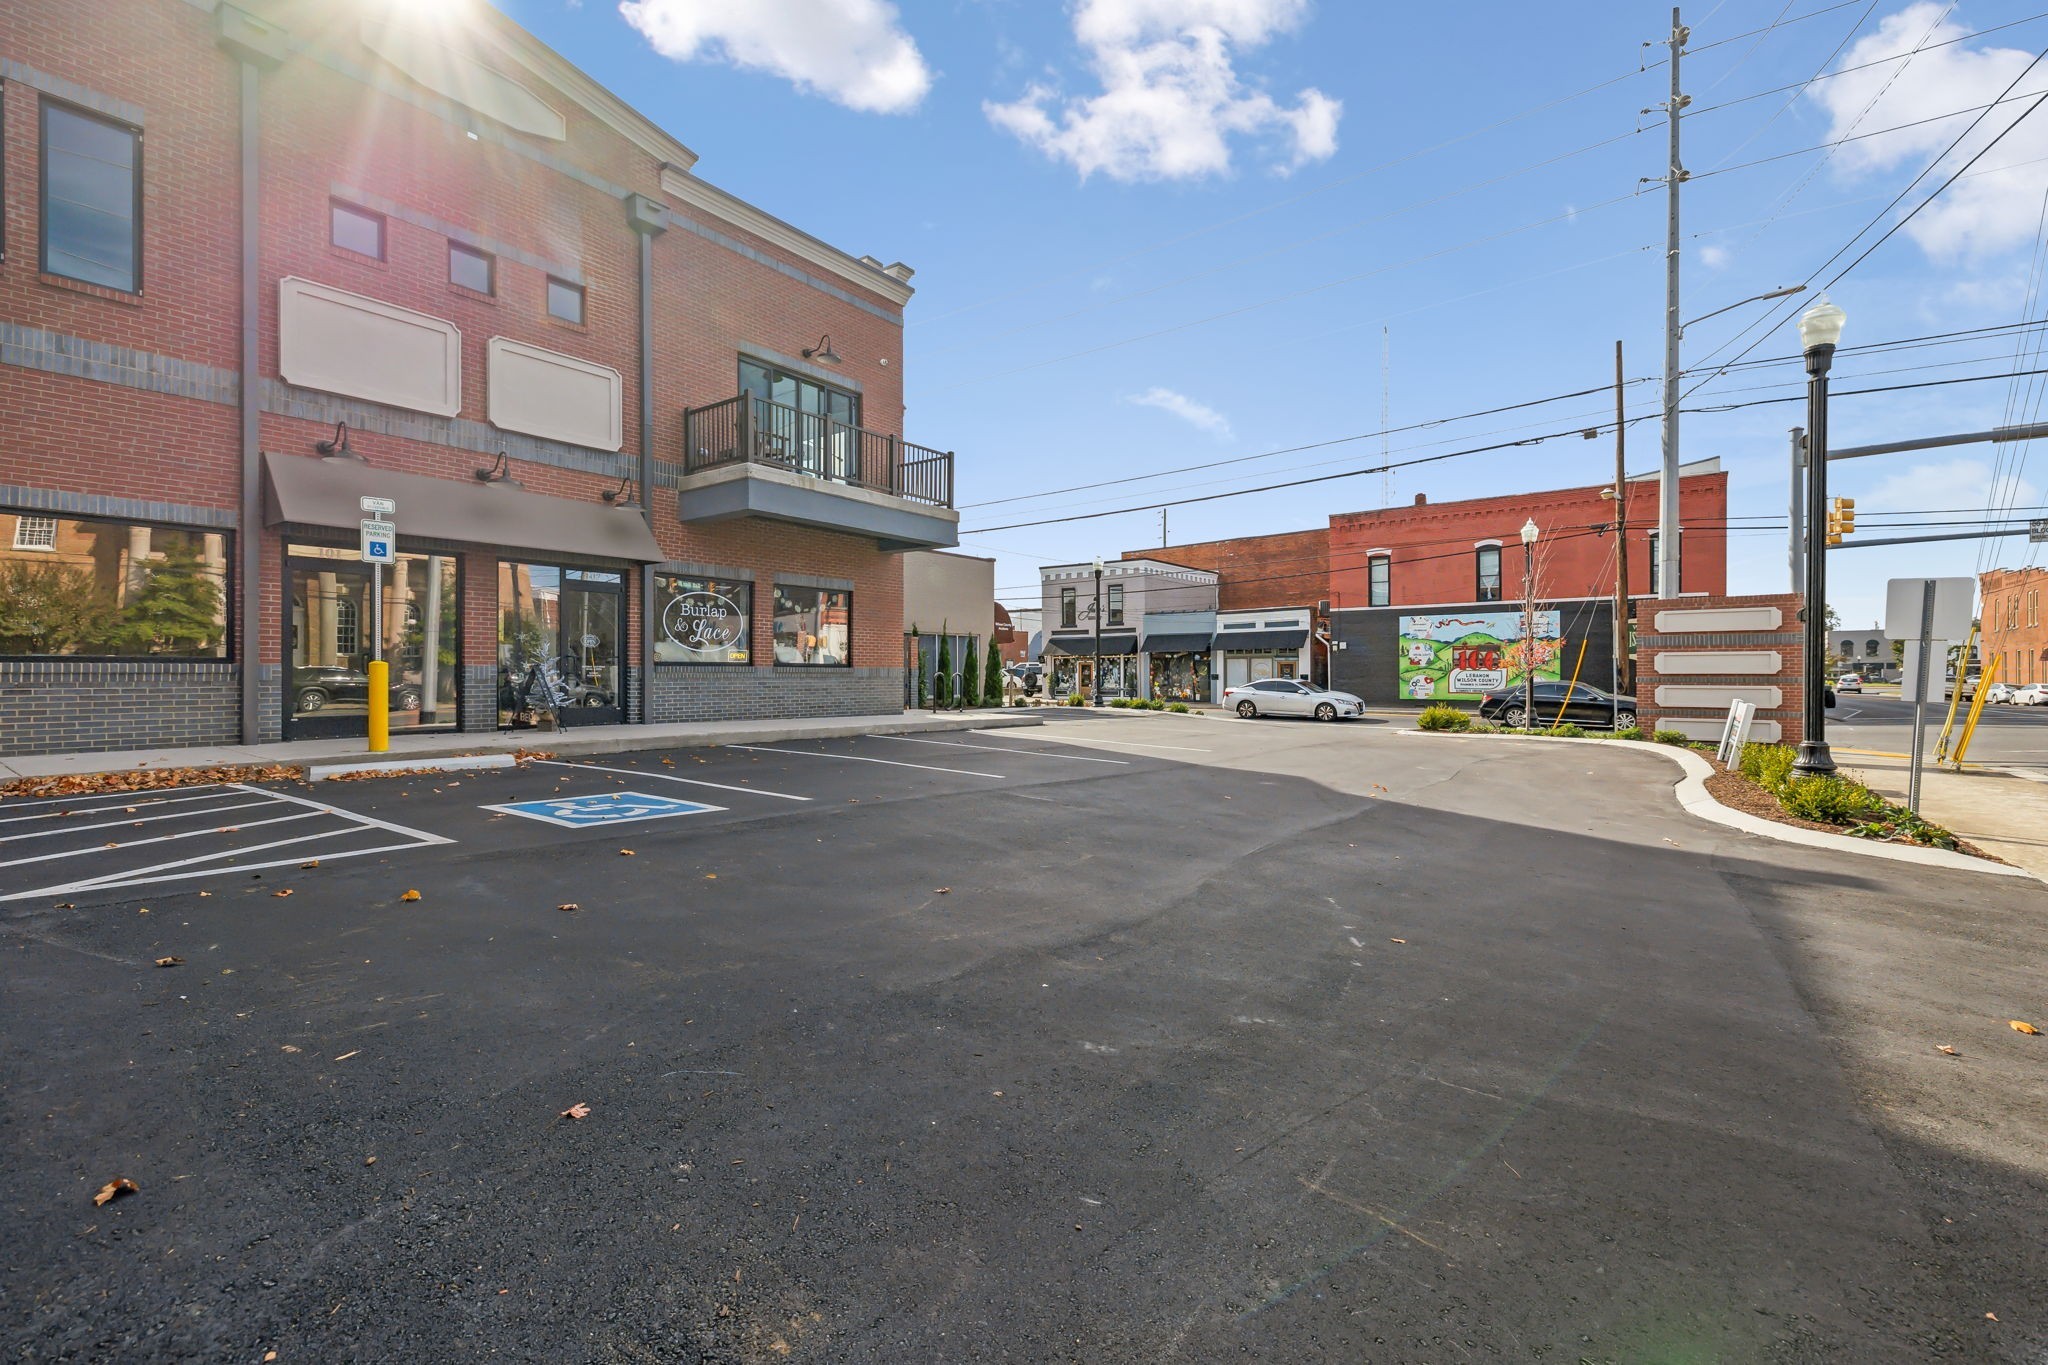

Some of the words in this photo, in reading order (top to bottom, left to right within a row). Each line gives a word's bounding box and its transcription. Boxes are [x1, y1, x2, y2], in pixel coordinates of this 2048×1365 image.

[363, 523, 393, 532] RESERVED
[366, 530, 391, 539] PARKING
[680, 603, 727, 620] Burlap
[675, 617, 689, 632] &
[689, 619, 731, 647] Lace
[729, 652, 746, 660] OPEN
